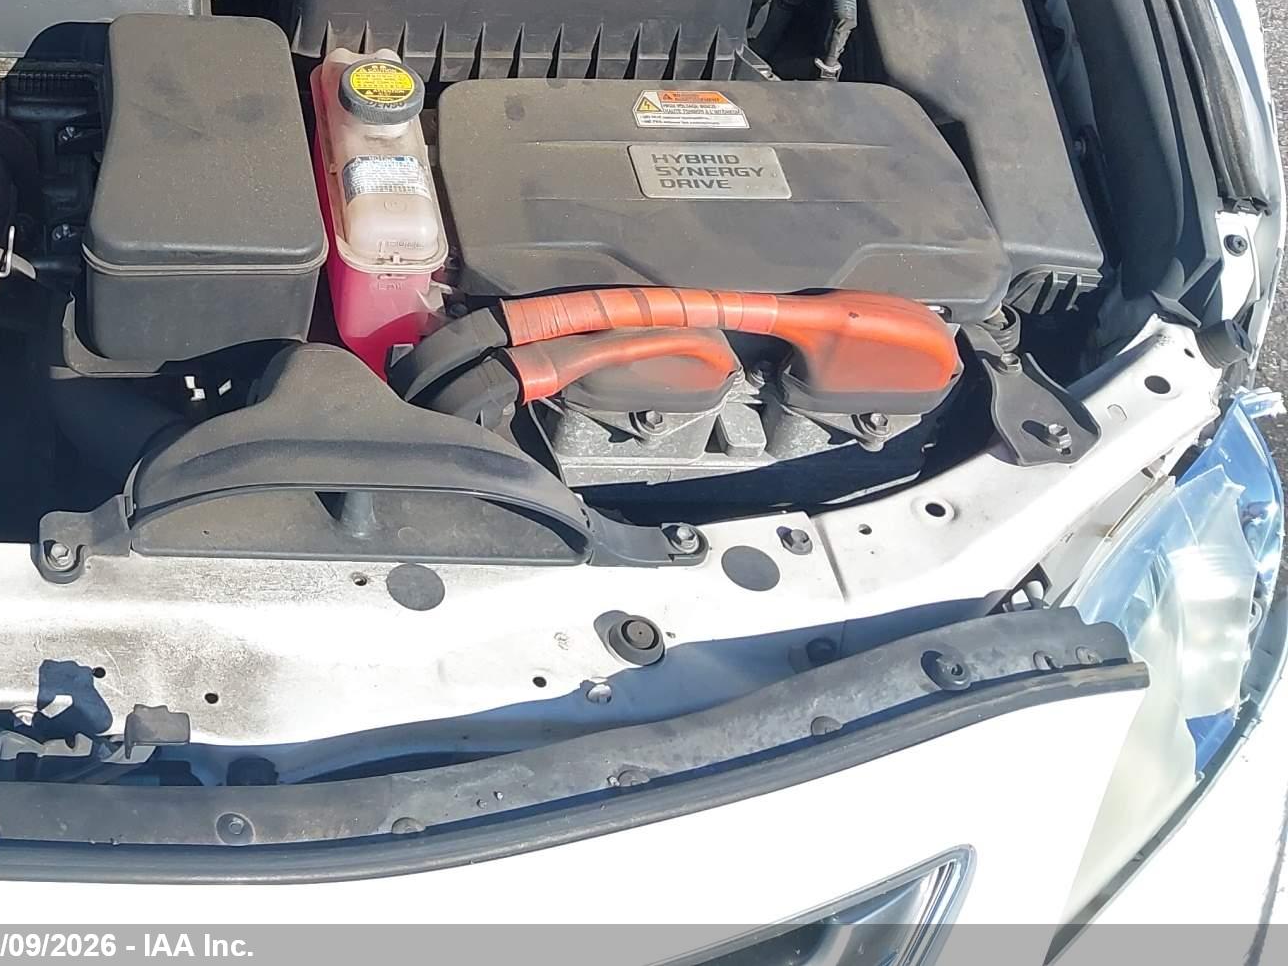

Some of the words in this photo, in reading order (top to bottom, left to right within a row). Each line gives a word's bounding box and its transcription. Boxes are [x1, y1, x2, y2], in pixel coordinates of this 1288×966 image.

[367, 100, 406, 110] DENSO
[652, 153, 739, 165] HYBRID
[655, 166, 764, 178] SYNERGY
[660, 178, 732, 190] DRIVE
